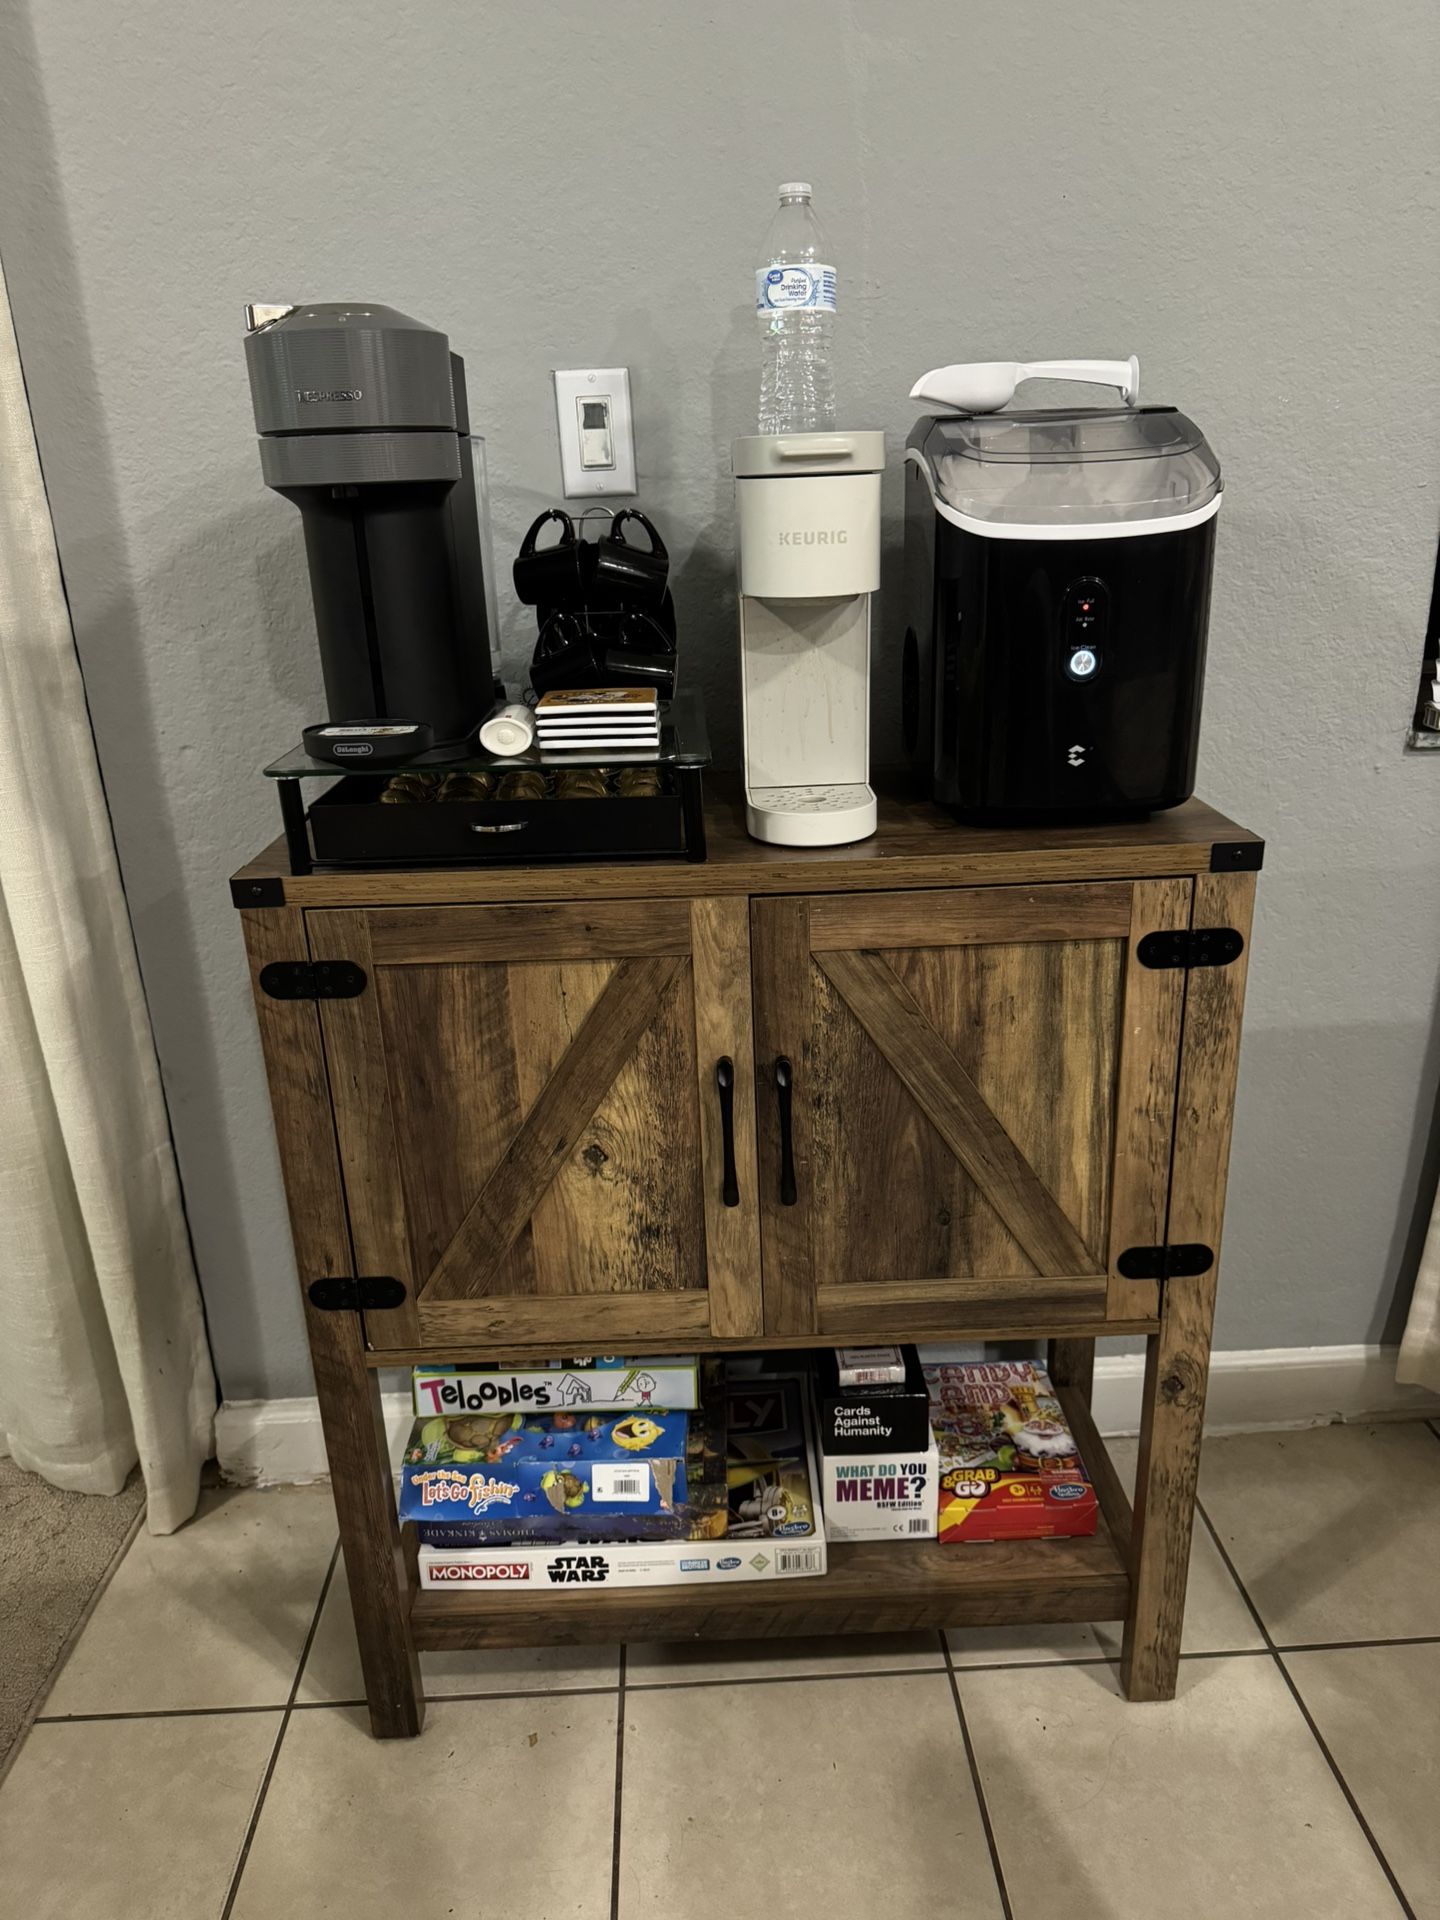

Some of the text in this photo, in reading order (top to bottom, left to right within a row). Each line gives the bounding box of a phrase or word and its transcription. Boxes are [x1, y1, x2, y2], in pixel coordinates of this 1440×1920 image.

[779, 530, 848, 546] KEURIG
[834, 1406, 871, 1416] Cards
[834, 1416, 880, 1428] Against
[834, 1426, 892, 1437] Humanity
[836, 1463, 927, 1478] WHAT DO YOU
[953, 1469, 996, 1482] GRAB
[422, 1480, 450, 1506] Let's
[450, 1482, 470, 1502] Go
[836, 1476, 927, 1502] MEME?
[943, 1476, 987, 1497] & GO
[771, 1508, 784, 1517] 8+
[547, 1556, 609, 1570] STAR
[432, 1565, 528, 1579] MONOPOLY
[547, 1569, 610, 1582] WARS
